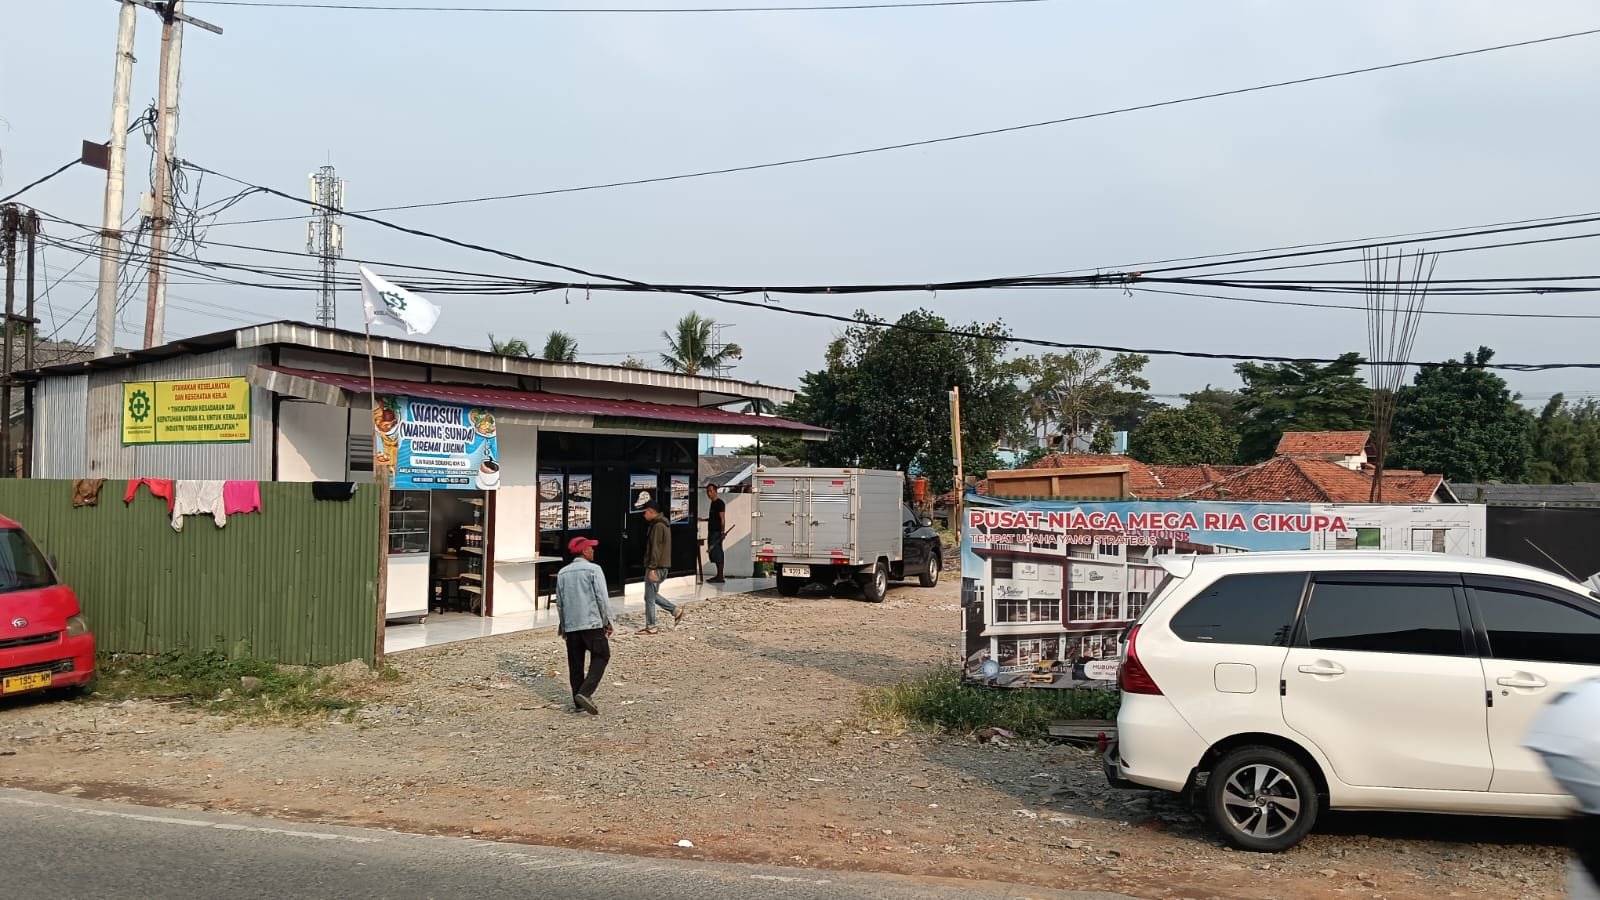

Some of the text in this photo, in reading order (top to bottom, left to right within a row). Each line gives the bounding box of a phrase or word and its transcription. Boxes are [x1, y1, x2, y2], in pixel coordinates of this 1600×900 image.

[197, 382, 230, 390] KESELAMATAN
[411, 404, 462, 425] WARSUN
[198, 423, 235, 431] BERKELANJUTAN
[400, 422, 475, 443] (WARUNG SUNDA)
[412, 441, 465, 454] CIREMAI LUGINA
[969, 512, 1042, 529] PUSAT
[1048, 512, 1123, 529] NIAGA
[1128, 512, 1198, 530] MEGA
[1204, 513, 1247, 531] RIA
[1252, 514, 1348, 533] CIKUPA
[970, 534, 1157, 546] TEMPAT USAHA YANG STRATEGIS
